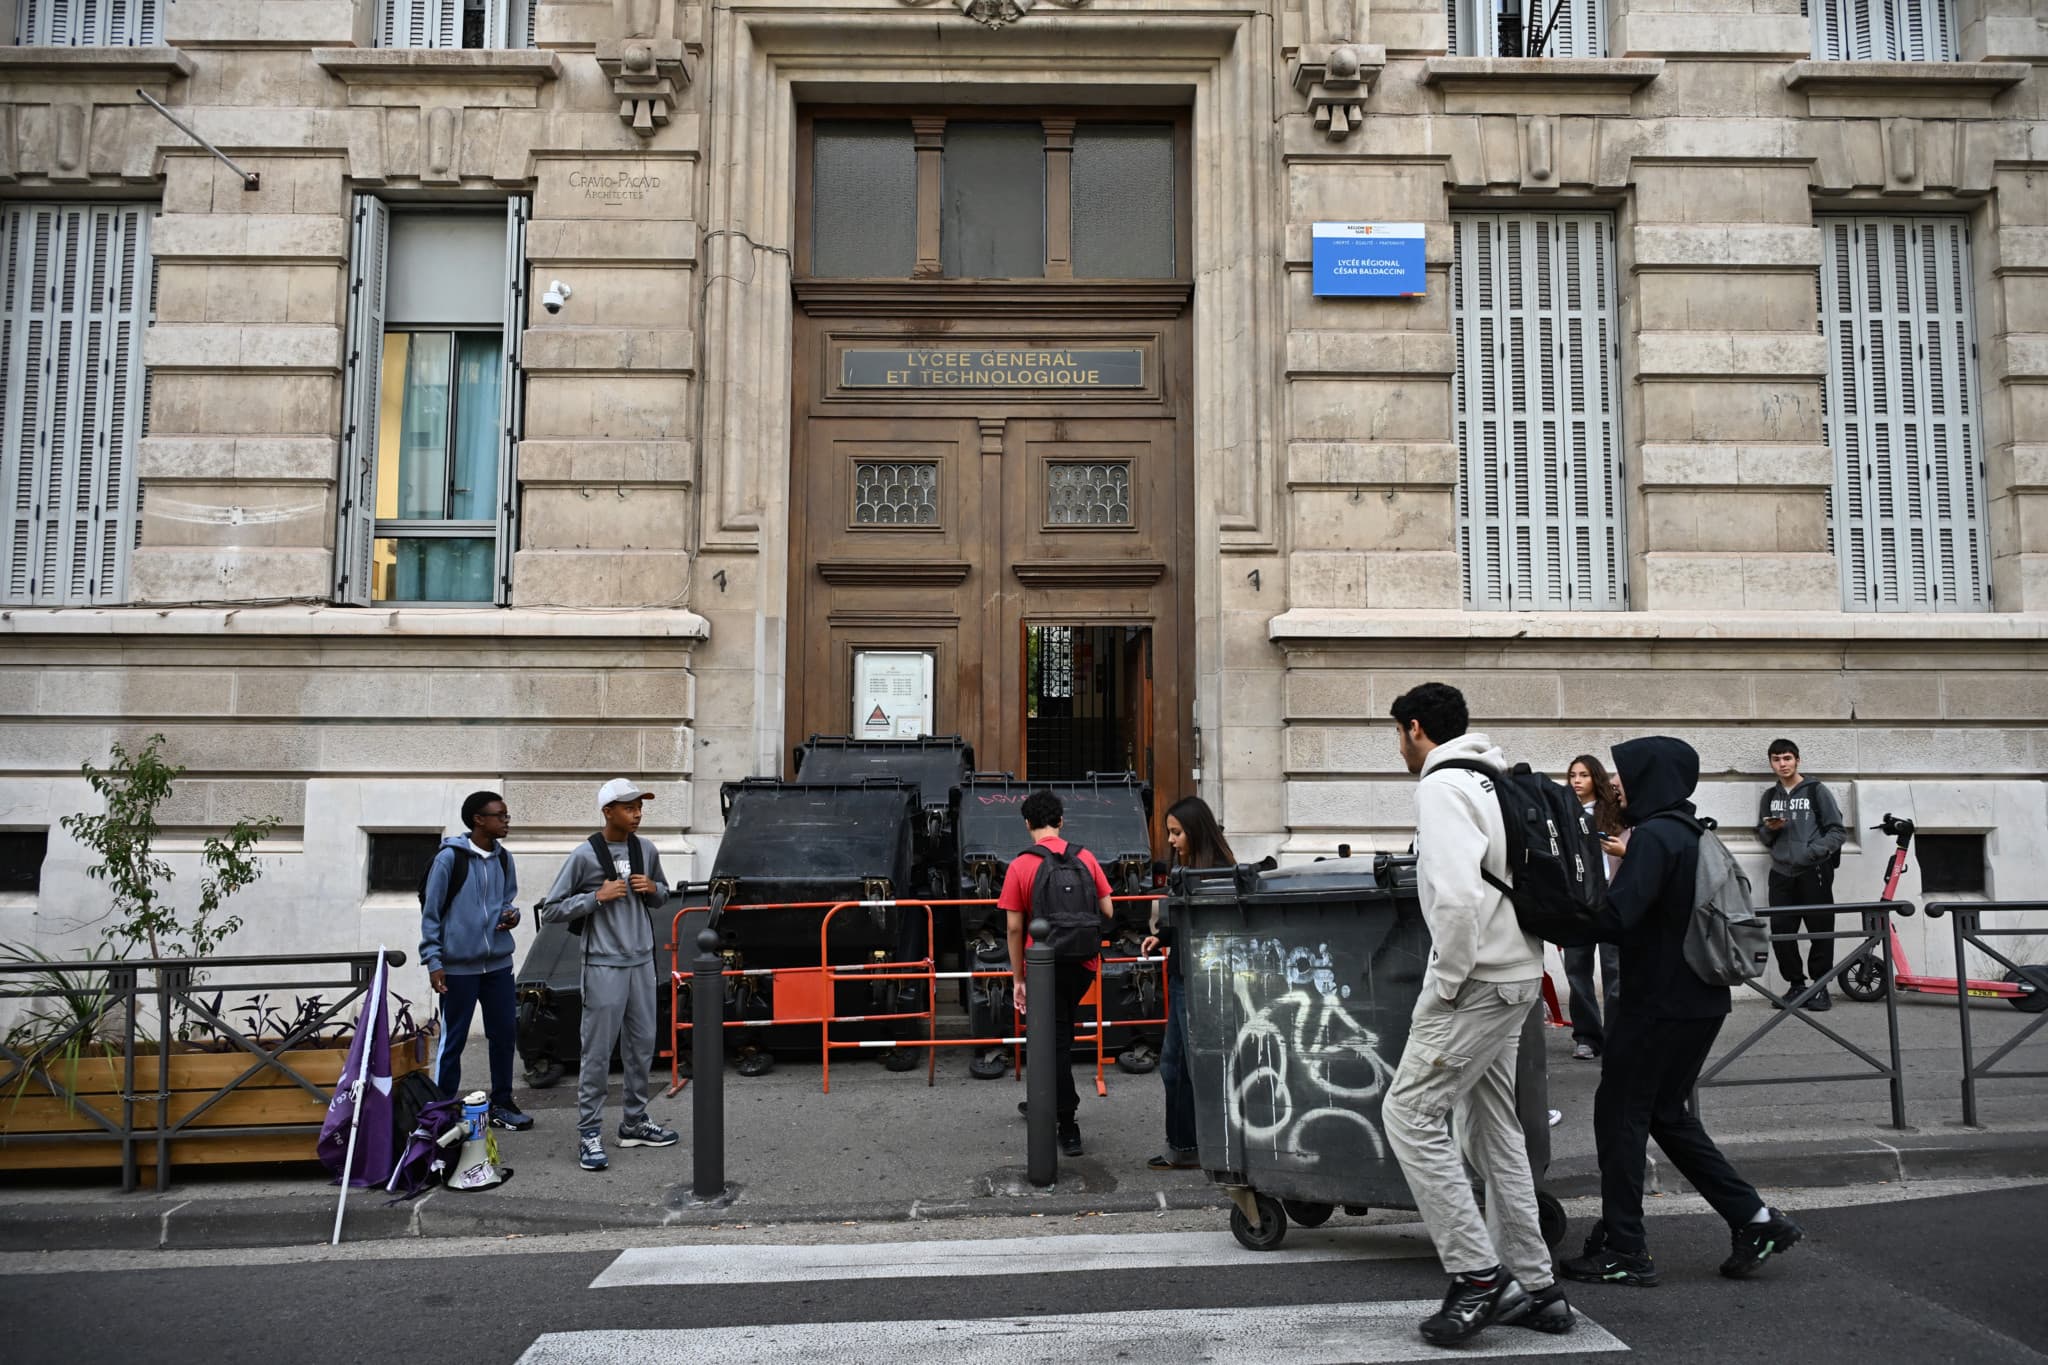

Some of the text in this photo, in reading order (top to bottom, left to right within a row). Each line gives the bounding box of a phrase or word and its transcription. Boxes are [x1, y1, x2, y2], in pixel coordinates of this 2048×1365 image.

[1338, 258, 1400, 267] LYCÉE RÉGIONAL
[1333, 266, 1358, 275] CÉSAR
[908, 353, 1078, 367] LYCEE GENERAL
[886, 370, 1100, 385] ET TECHNOLOGIQUE
